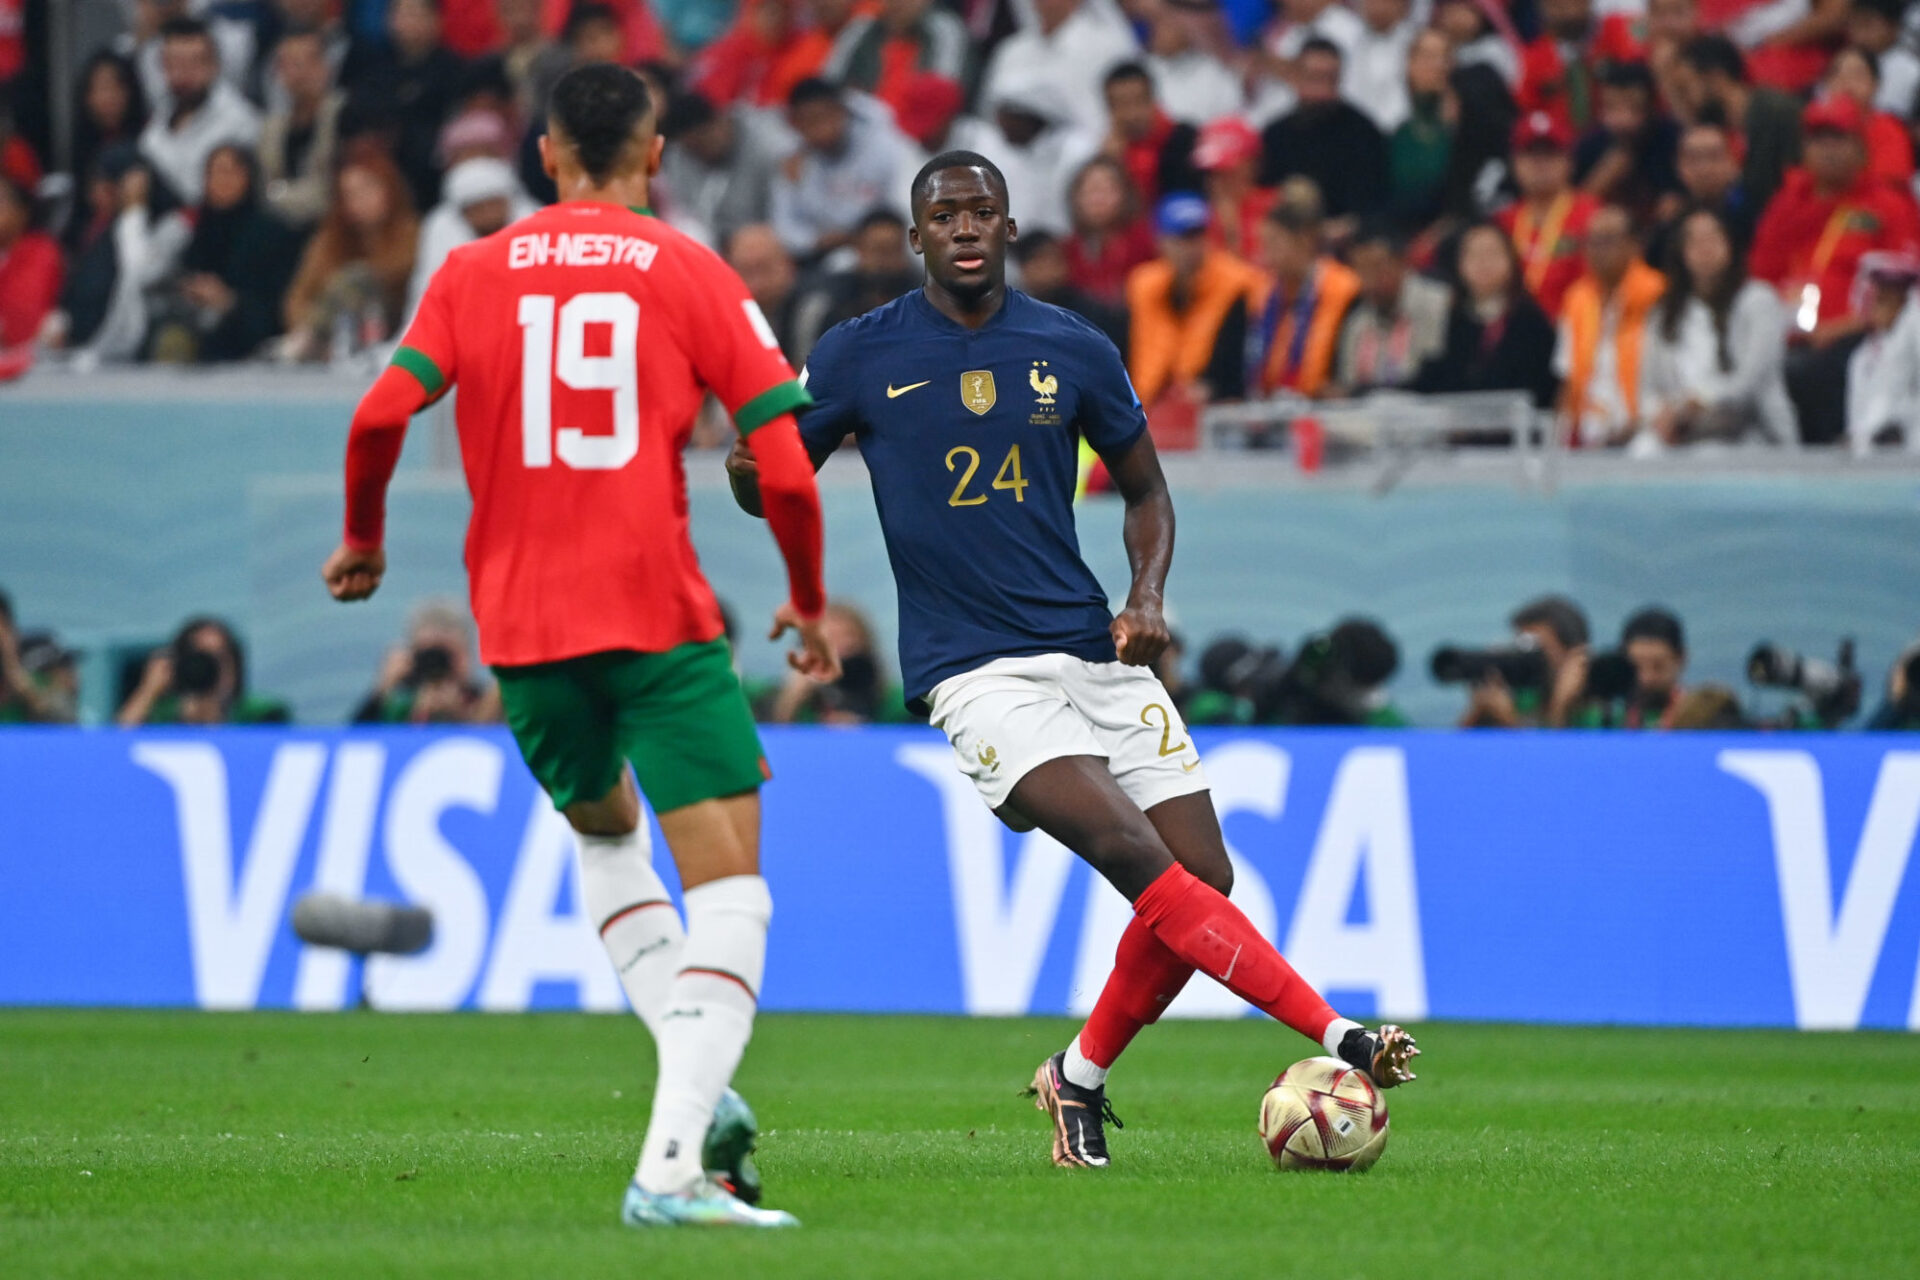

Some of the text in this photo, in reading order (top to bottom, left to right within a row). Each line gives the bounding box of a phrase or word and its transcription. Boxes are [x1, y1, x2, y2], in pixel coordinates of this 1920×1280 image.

[508, 232, 659, 271] EN-NESYRI
[518, 292, 640, 470] 19
[945, 443, 1029, 506] 24
[1140, 703, 1189, 757] 2
[130, 737, 633, 1012] VISA
[1716, 748, 1920, 1032] V
